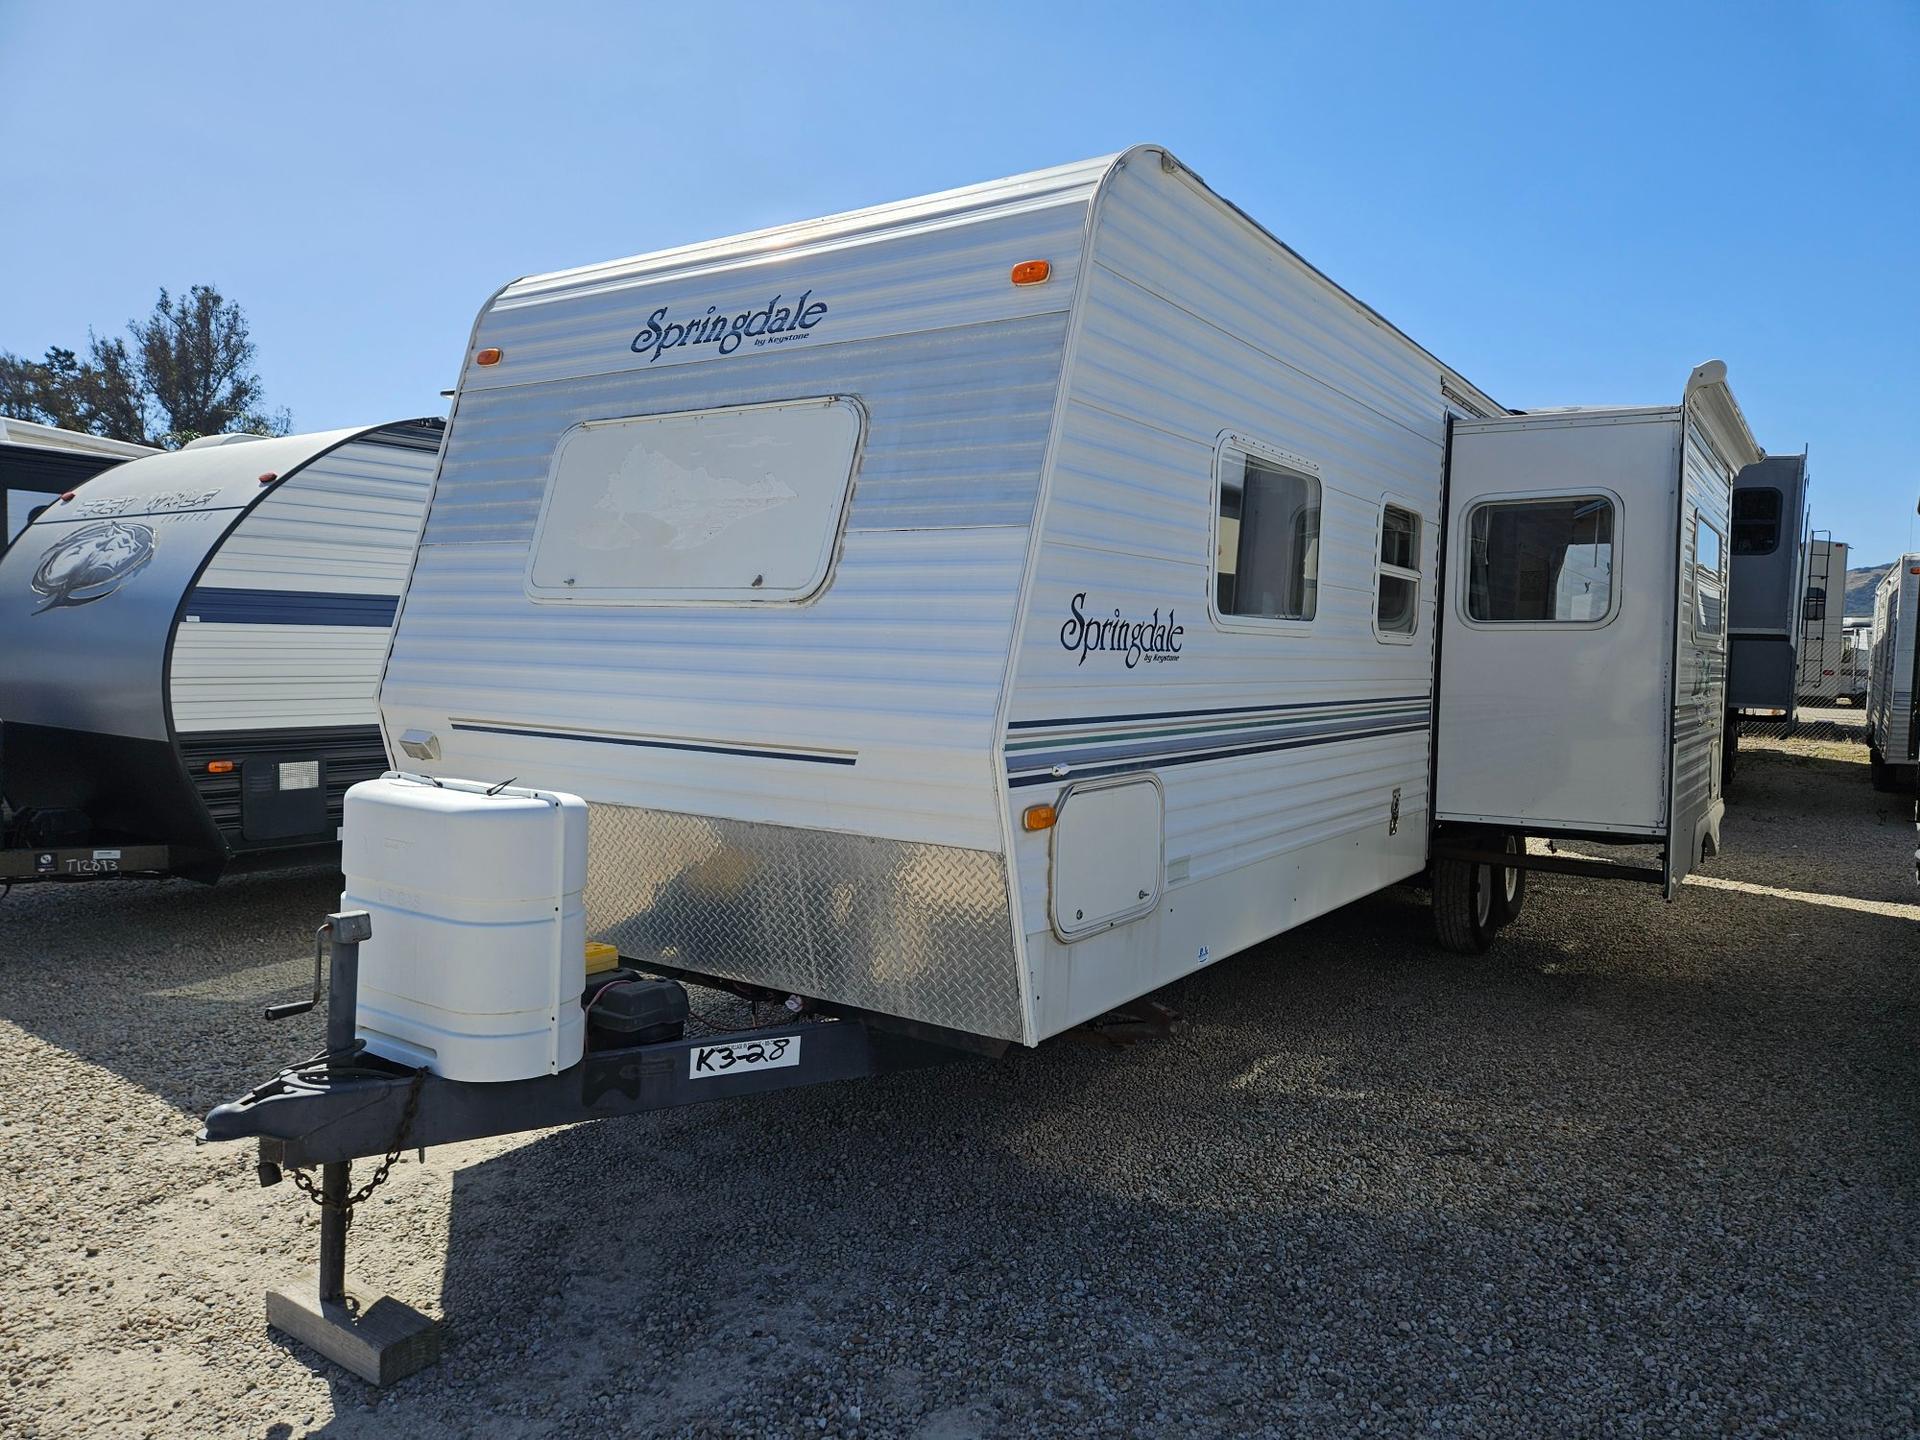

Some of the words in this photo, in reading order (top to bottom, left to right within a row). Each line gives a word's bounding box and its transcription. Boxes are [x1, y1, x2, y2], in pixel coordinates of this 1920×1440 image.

[631, 290, 828, 363] Springdale
[754, 339, 766, 347] by
[768, 333, 810, 344] Keystone
[1061, 592, 1184, 669] Springdale
[696, 1039, 790, 1072] K3-28
